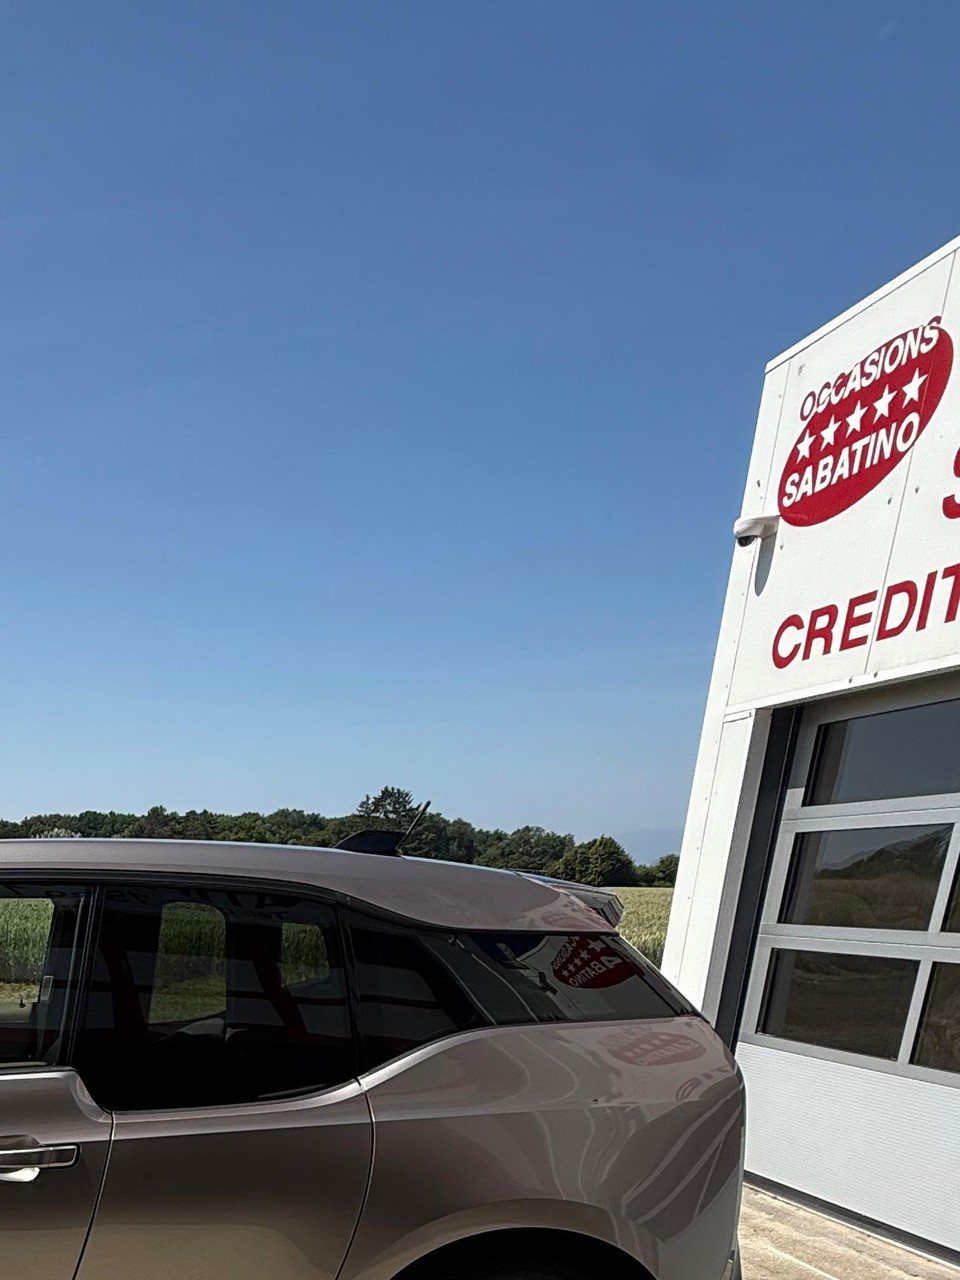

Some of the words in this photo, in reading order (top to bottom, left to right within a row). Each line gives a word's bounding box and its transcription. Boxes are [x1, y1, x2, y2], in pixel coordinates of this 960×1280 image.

[800, 315, 942, 421] OCCASIONS
[782, 412, 920, 507] SABATINO
[772, 563, 960, 669] CREDIT
